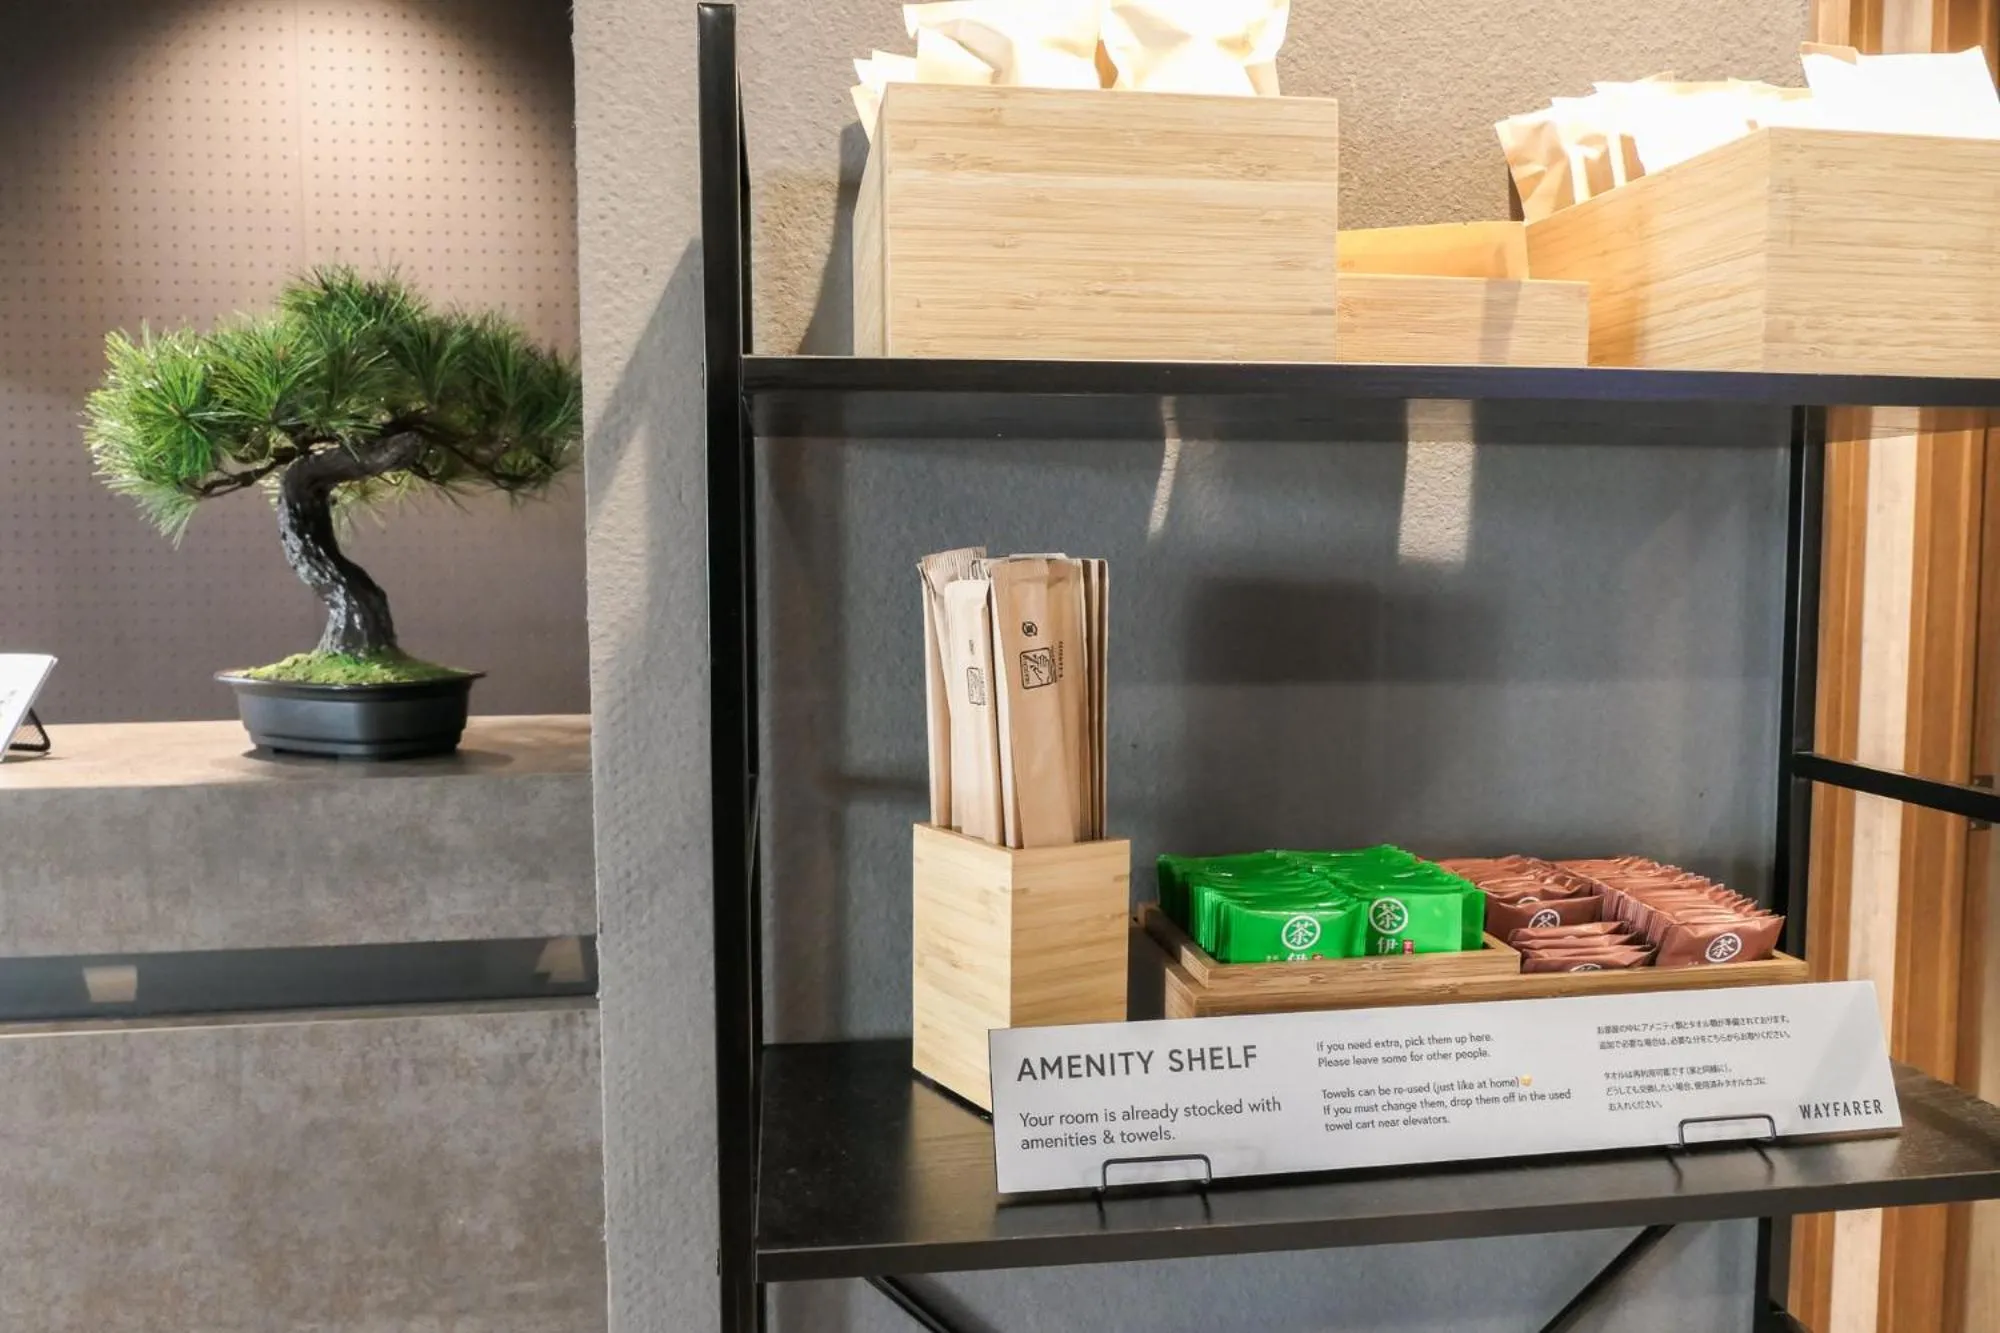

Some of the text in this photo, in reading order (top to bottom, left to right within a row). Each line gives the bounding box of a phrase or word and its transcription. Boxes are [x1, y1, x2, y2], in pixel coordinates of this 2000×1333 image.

[1375, 902, 1403, 928] 茶
[1287, 921, 1316, 946] 茶
[1376, 936, 1398, 954] 伊
[1709, 935, 1738, 959] 茶
[1317, 1032, 1494, 1054] If you need extra, pick them up here.
[1017, 1045, 1257, 1082] AMENITY SHELF
[1318, 1048, 1490, 1067] Please leave some for other people.
[1322, 1076, 1519, 1099] Towels can be re-used (just like at home)
[1020, 1097, 1281, 1128] Your room is already stocked with
[1324, 1089, 1572, 1118] If you must change them, drop them off in the used
[1799, 1099, 1883, 1119] WAYFARER
[1325, 1114, 1450, 1132] towel cart near elevators.
[1021, 1126, 1176, 1150] amenities & towels.
